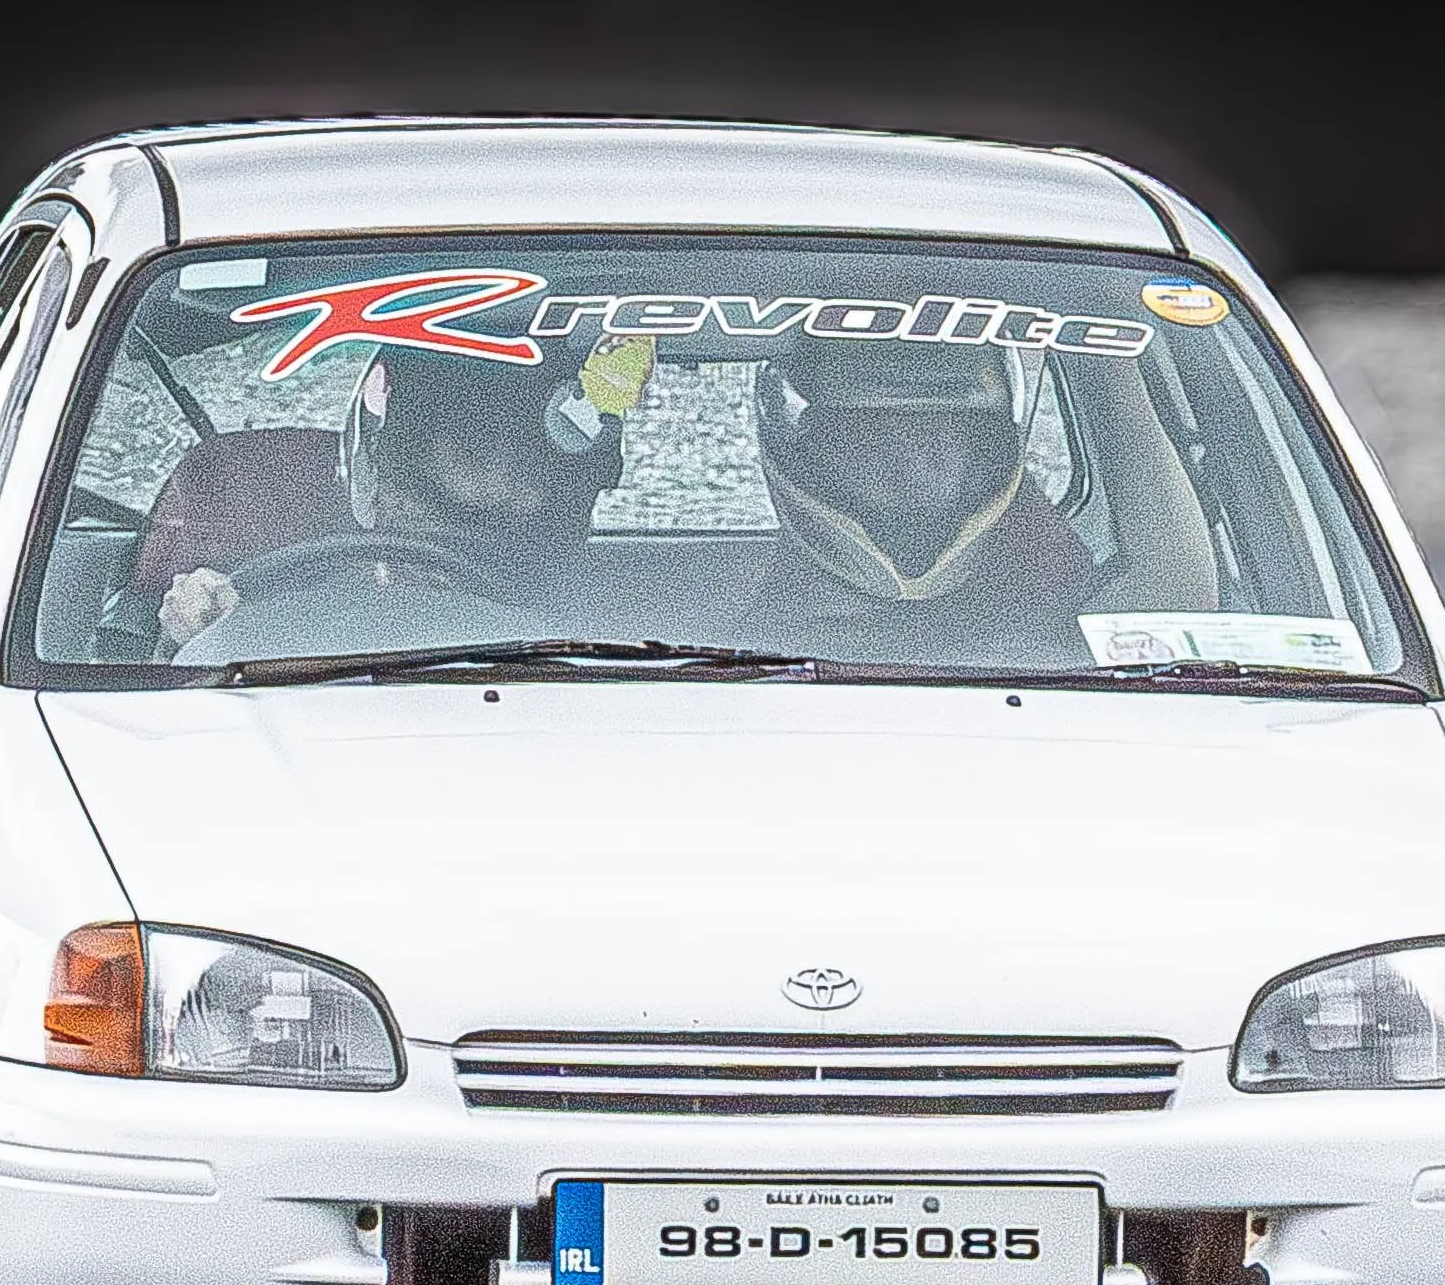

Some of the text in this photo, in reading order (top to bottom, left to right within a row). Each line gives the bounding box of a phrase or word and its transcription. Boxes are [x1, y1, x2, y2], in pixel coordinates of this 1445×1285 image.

[528, 294, 1155, 356] revolite
[659, 1225, 1041, 1260] 98-D-15085
[559, 1248, 601, 1273] IRL
